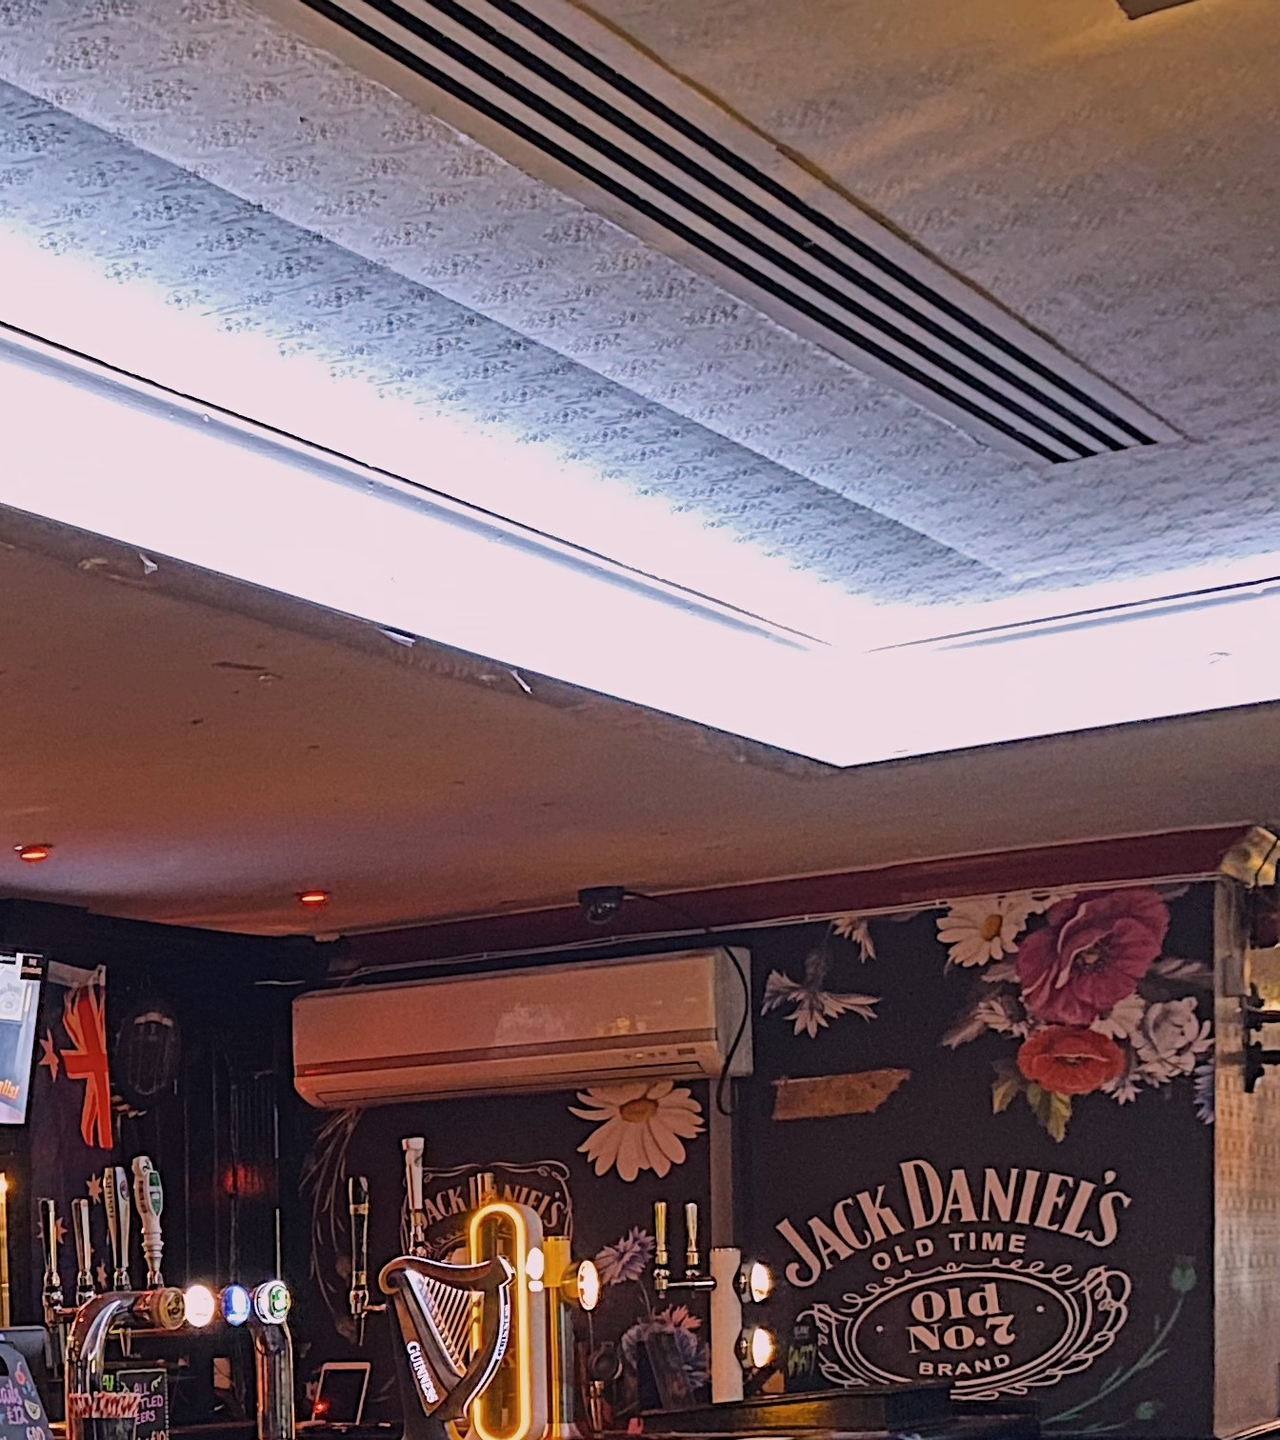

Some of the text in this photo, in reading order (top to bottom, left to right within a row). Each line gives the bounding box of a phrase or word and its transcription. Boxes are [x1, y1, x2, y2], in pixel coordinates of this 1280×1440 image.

[775, 1158, 1133, 1289] JACK DANIEL'S
[872, 1230, 1028, 1271] OLD TIME
[910, 1281, 1001, 1324] Old
[406, 1340, 440, 1404] GUINNESS
[918, 1353, 1011, 1377] BRAND
[135, 1410, 156, 1425] EERS
[140, 1394, 164, 1409] TLED
